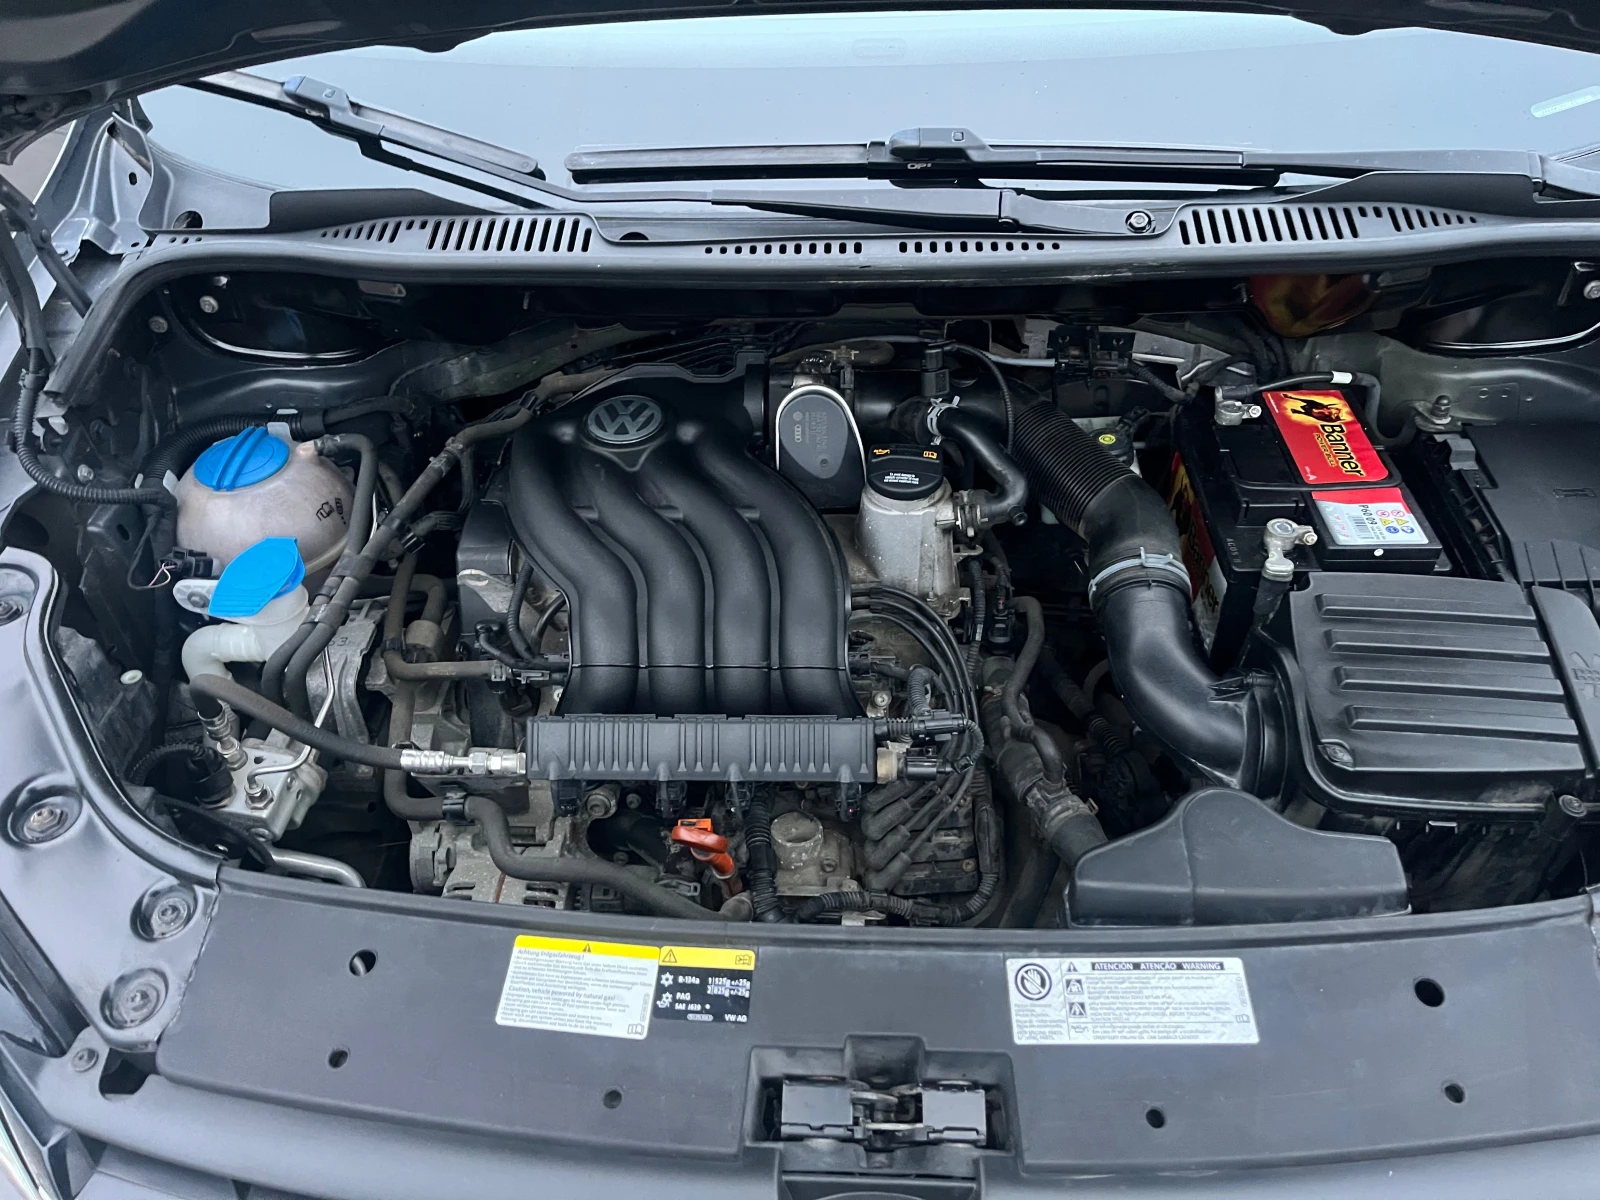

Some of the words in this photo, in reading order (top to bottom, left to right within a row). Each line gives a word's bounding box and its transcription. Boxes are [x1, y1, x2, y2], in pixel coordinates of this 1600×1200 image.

[1320, 424, 1364, 477] Banner
[1358, 504, 1373, 518] P60
[1094, 961, 1132, 969] ATENCIÓN
[1140, 961, 1176, 970] ATENÇÃO
[678, 976, 700, 984] R-134a
[509, 985, 531, 993] Caution,
[552, 989, 576, 997] powered
[576, 991, 582, 999] by
[676, 992, 691, 1000] PAG
